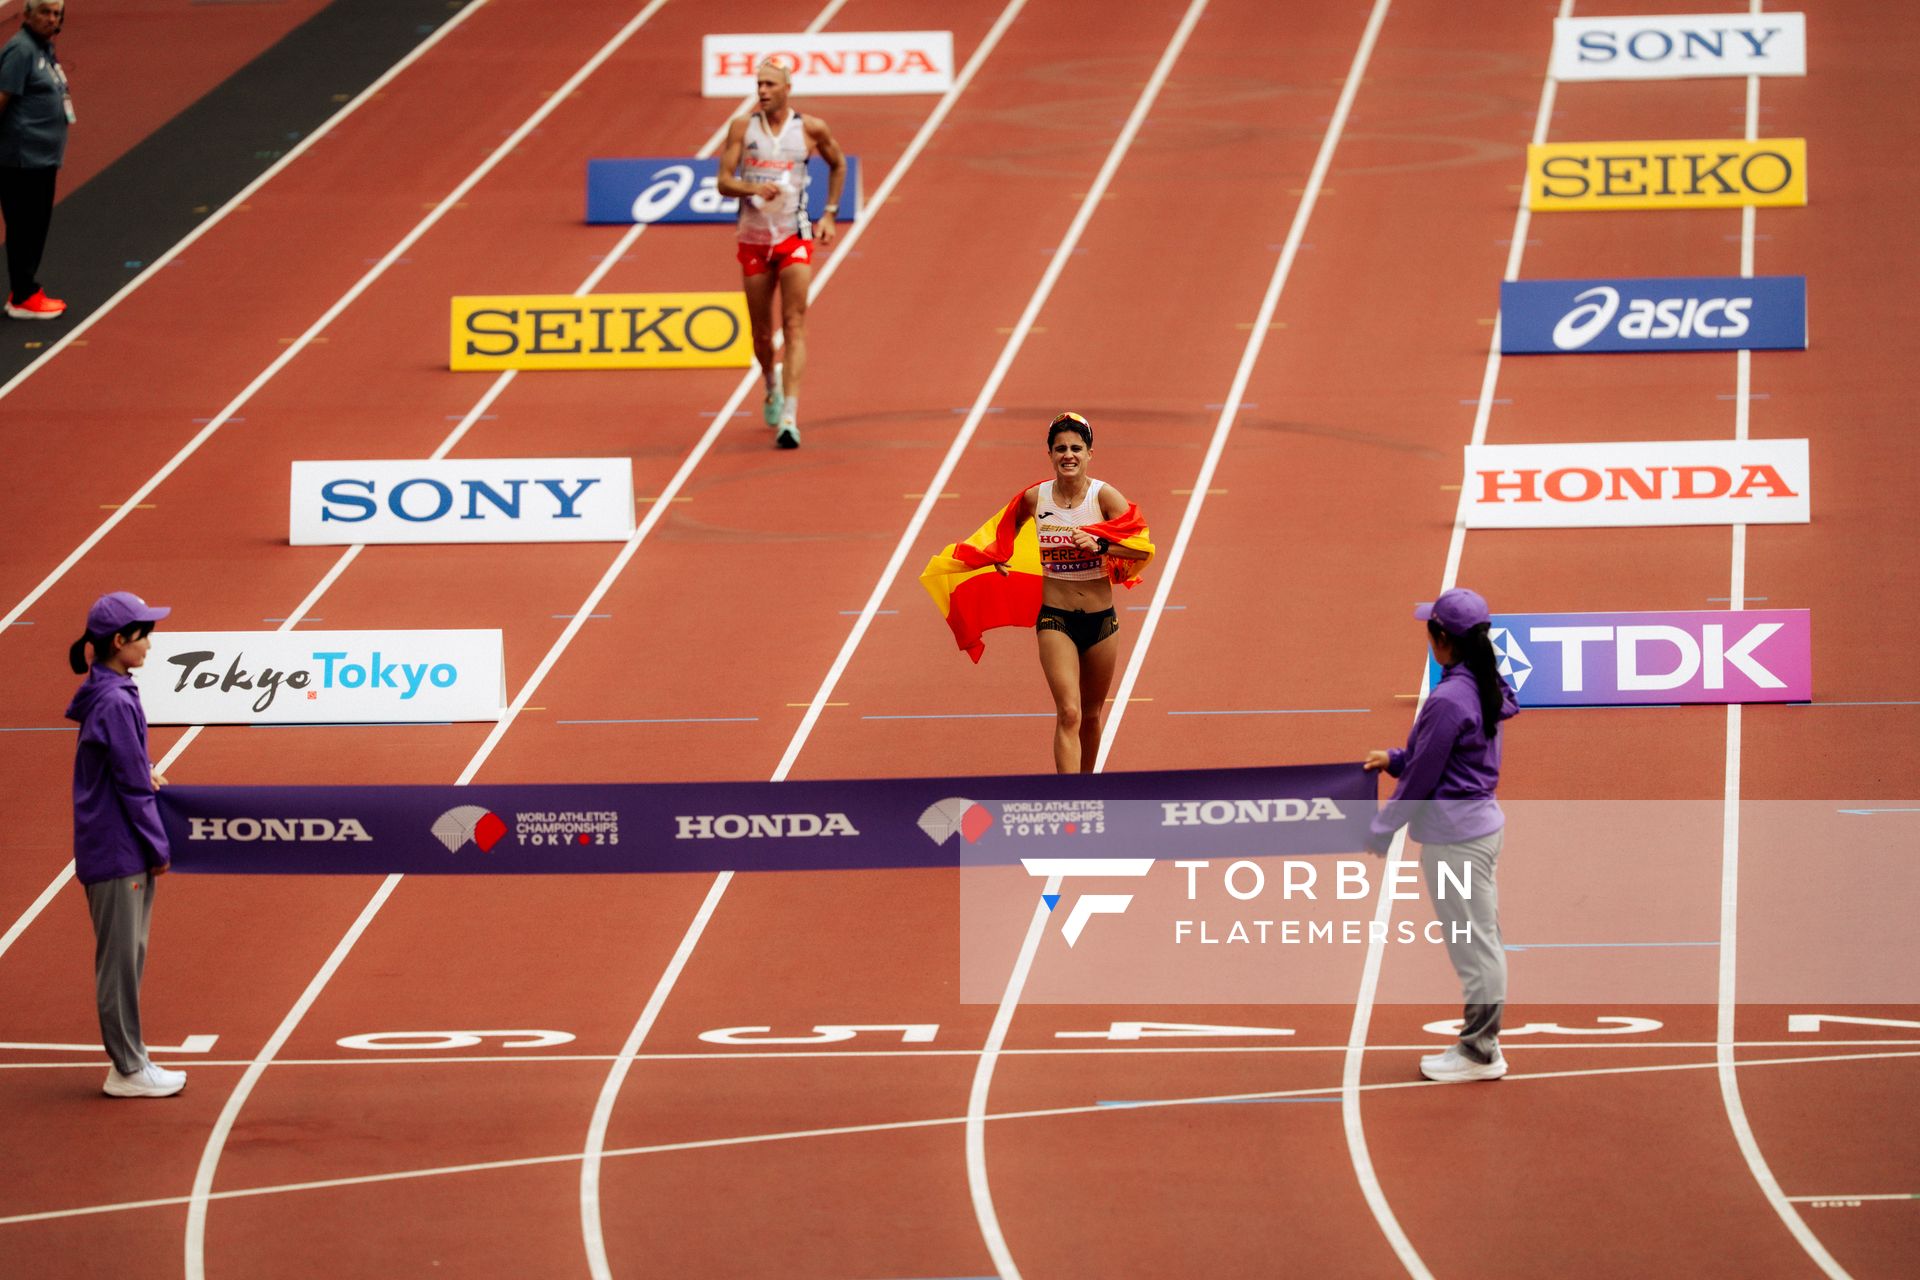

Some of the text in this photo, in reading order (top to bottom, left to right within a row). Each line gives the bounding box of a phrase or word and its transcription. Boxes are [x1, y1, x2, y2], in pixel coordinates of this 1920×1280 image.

[1578, 29, 1781, 63] SONY
[1542, 152, 1792, 198] SEIKO
[466, 304, 740, 356] SEIKO
[1618, 297, 1752, 339] asics
[1476, 464, 1798, 503] HONDA
[321, 478, 601, 523] SONY
[1530, 623, 1788, 691] TDK
[167, 650, 458, 713] Tokyo Tokyo
[516, 812, 618, 822] WORLD ATHLETICS
[1002, 801, 1104, 813] WORLD ATHLETICS
[1002, 811, 1105, 824] CHAMPIONSHIPS
[1162, 797, 1346, 826] HONDA
[188, 818, 373, 841] HONDA
[516, 822, 618, 833] CHAMPIONSHIPS
[675, 812, 860, 839] HONDA
[336, 1029, 577, 1050] 6
[698, 1023, 940, 1045] 5
[1054, 1021, 1297, 1041] 4
[1422, 1016, 1664, 1036] 3
